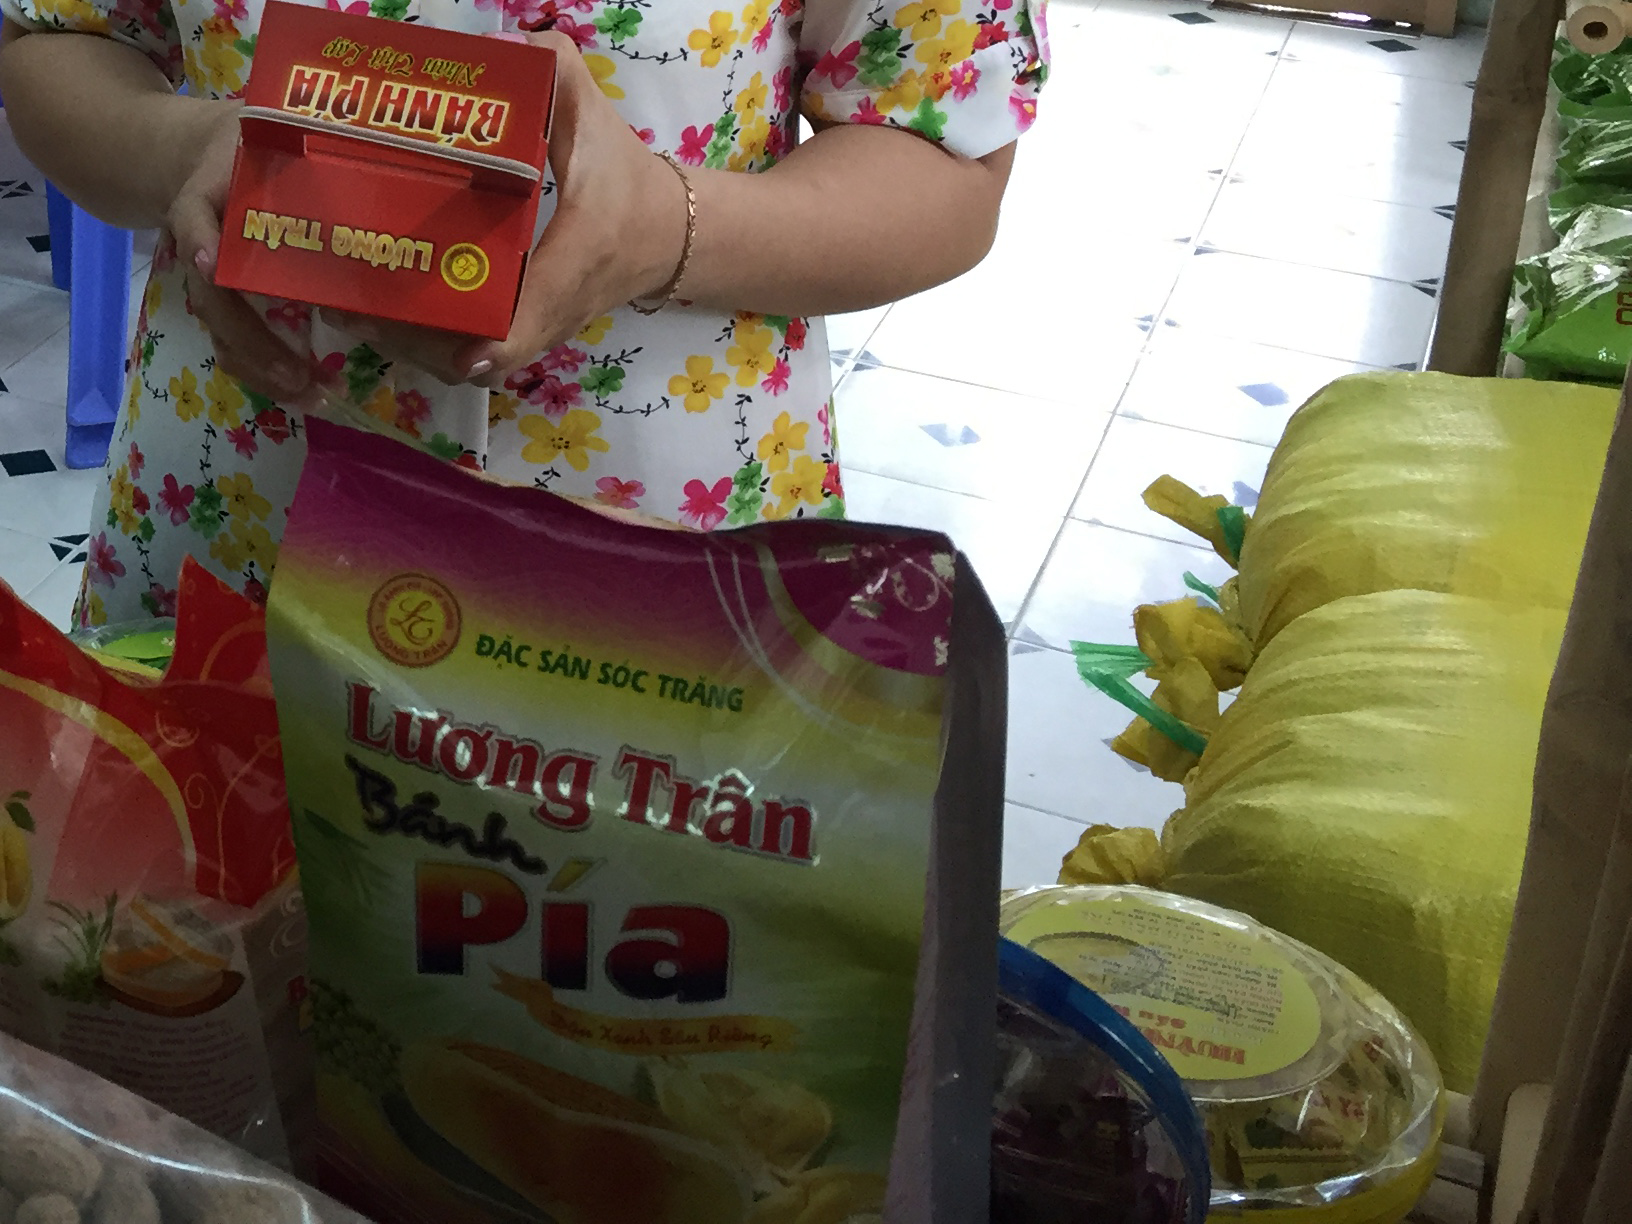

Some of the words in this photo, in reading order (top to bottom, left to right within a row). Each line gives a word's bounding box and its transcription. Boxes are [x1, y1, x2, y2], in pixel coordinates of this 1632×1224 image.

[283, 65, 369, 123] PÍA
[368, 80, 510, 148] BÁNH
[242, 209, 324, 252] TRÂN
[331, 225, 433, 272] LƯƠNG
[475, 633, 532, 670] ĐẶC
[538, 643, 592, 681] SẢN
[597, 658, 649, 694] SÓC
[657, 673, 746, 712] TRĂNG
[346, 677, 598, 829] Lương
[614, 747, 821, 867] Trân
[344, 753, 549, 878] Bánh
[413, 855, 737, 1006] Pía
